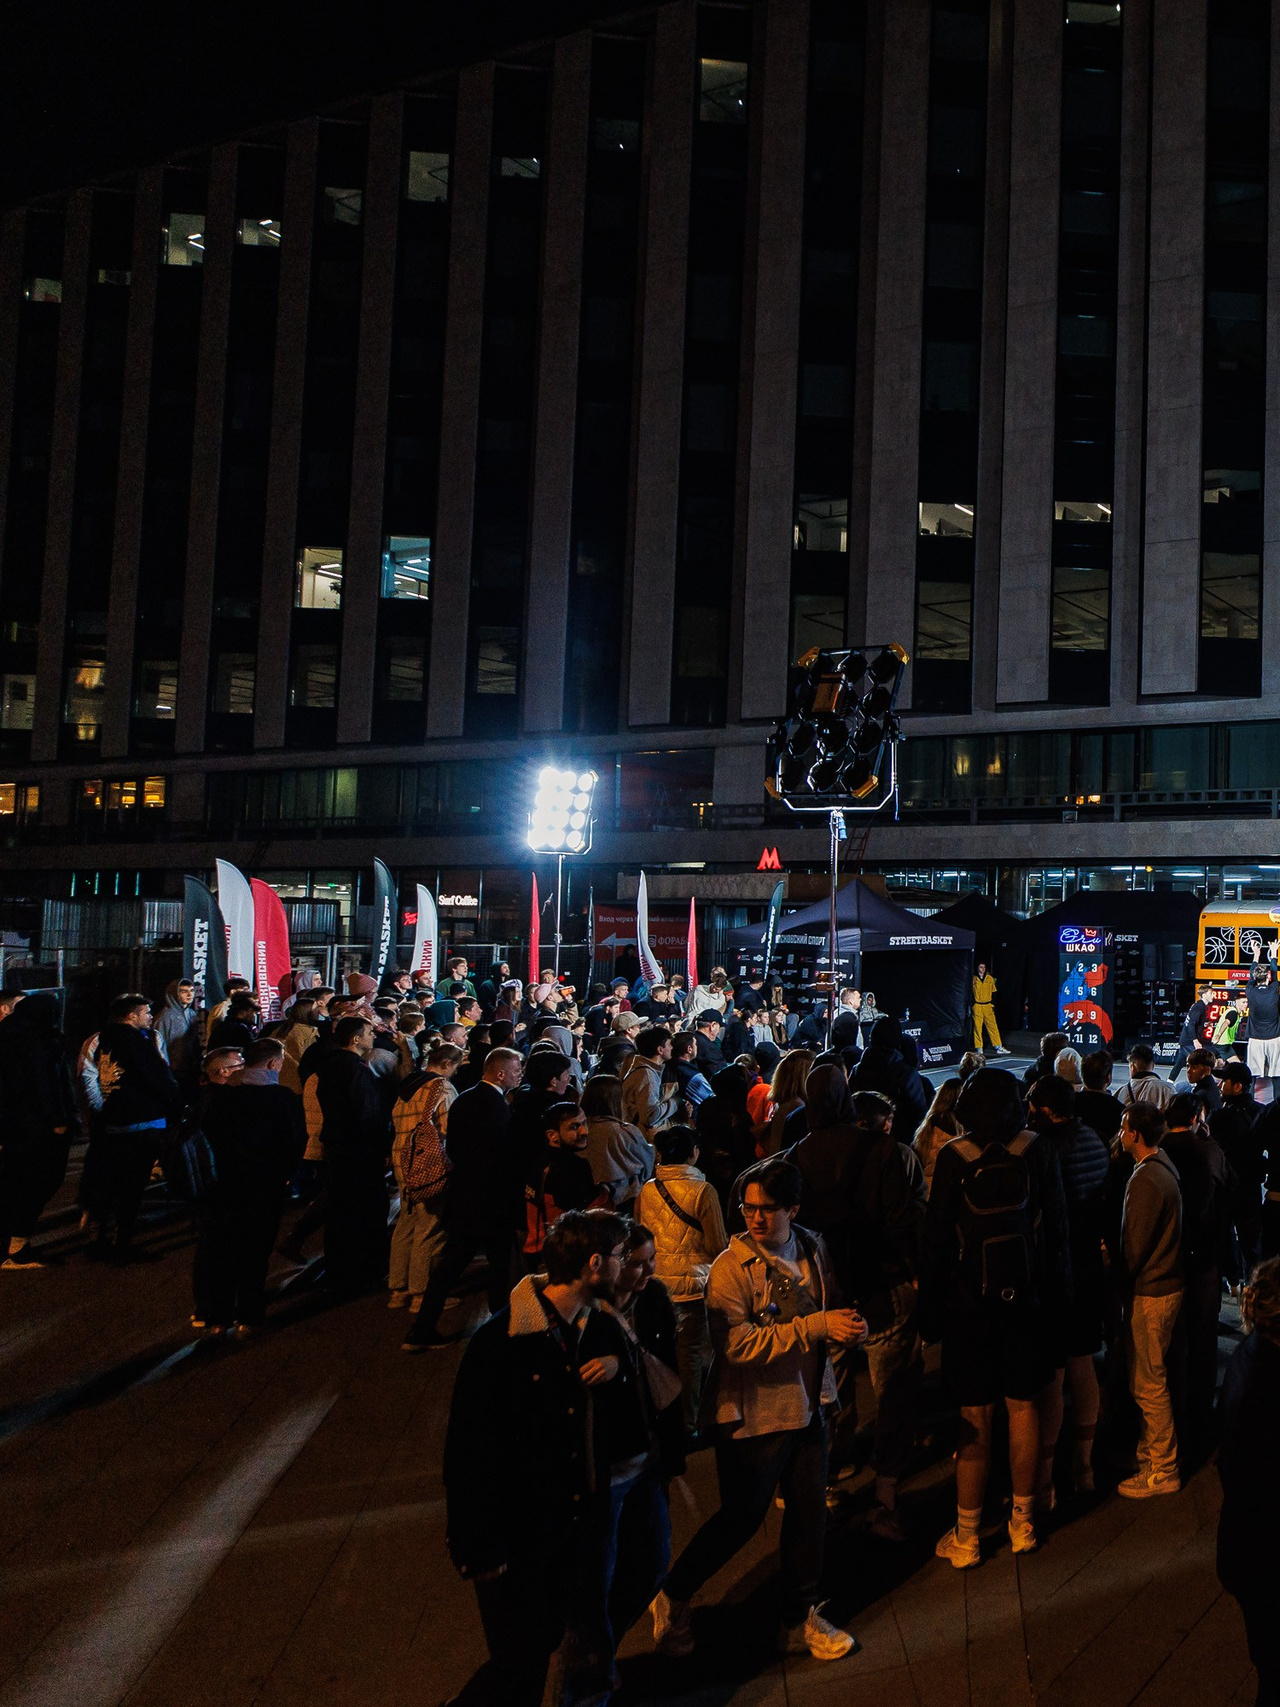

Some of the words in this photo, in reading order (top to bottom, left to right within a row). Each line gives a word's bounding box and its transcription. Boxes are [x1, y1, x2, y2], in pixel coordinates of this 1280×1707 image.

[757, 846, 781, 870] М
[658, 936, 687, 945] ФОРАБ
[889, 935, 953, 945] STREETBASKET
[1066, 943, 1095, 952] ШКАФ
[192, 918, 209, 1009] TBASKET
[1066, 963, 1070, 972] 1
[1078, 963, 1084, 972] 2
[1091, 963, 1098, 972] 3
[1064, 986, 1070, 995] 4
[1077, 987, 1084, 995] 5
[1091, 987, 1097, 996] 6
[1077, 1010, 1084, 1019] 8
[1090, 1011, 1096, 1019] 9
[1075, 1034, 1083, 1043] 11
[1089, 1034, 1098, 1043] 12
